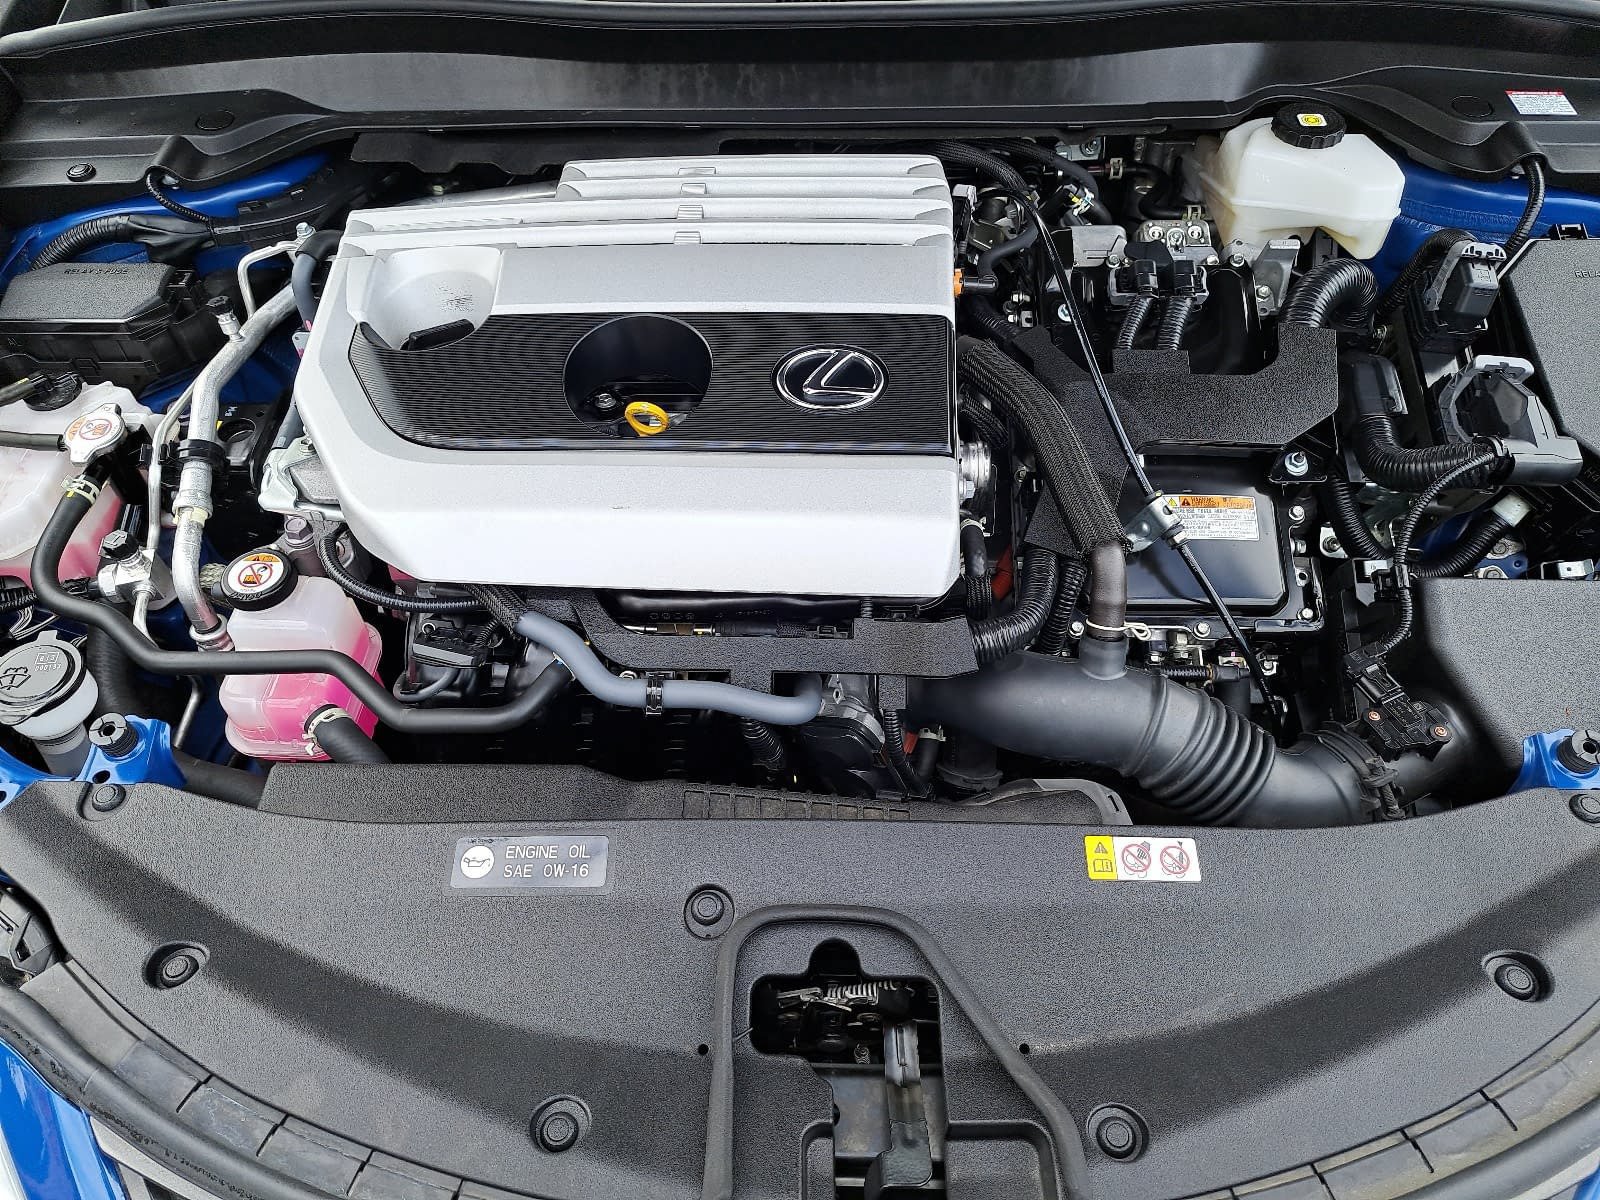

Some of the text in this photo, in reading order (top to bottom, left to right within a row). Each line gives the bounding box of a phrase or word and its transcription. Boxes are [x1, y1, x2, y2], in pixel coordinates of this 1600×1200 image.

[505, 844, 590, 859] ENGINE OIL
[503, 863, 589, 878] SAE 0W-16
